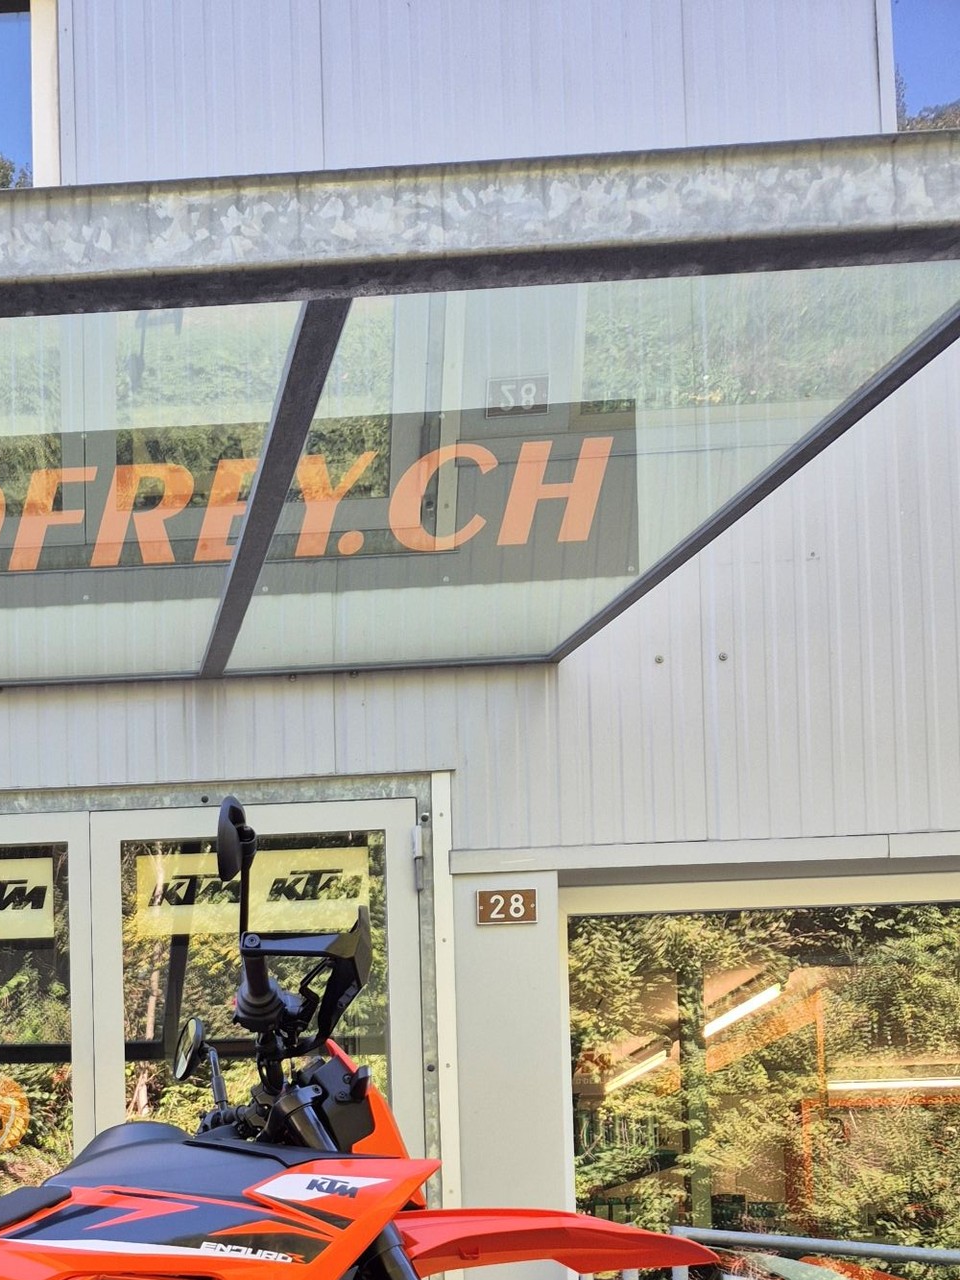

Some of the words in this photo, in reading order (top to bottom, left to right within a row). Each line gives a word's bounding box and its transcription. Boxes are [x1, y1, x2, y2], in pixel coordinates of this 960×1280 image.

[148, 873, 241, 907] KTM
[267, 868, 363, 902] KTM
[489, 893, 526, 920] 28
[306, 1176, 361, 1199] KTM
[200, 1241, 294, 1264] ENDURO
